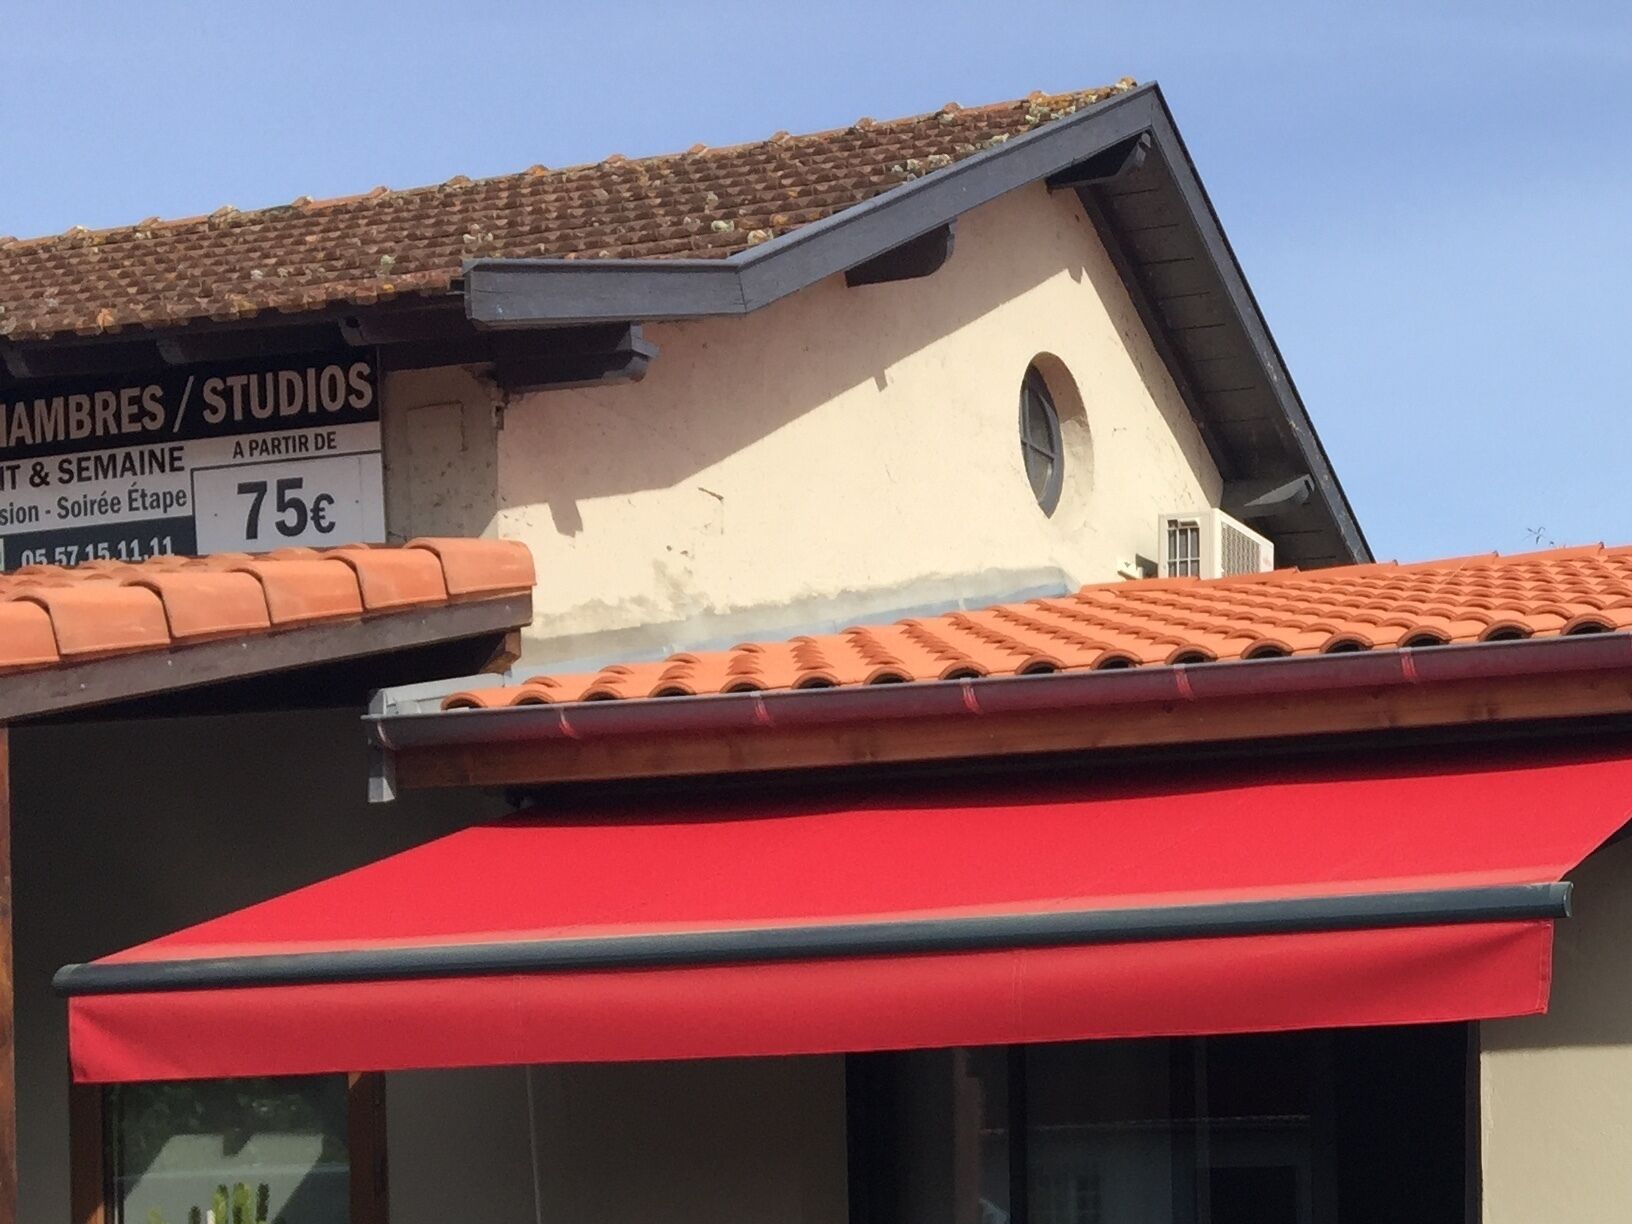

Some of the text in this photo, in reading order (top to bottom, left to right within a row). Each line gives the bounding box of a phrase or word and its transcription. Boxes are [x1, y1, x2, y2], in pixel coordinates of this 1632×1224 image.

[0, 385, 165, 448] AMBRES
[202, 361, 373, 424] STUDIOS
[233, 431, 337, 459] A PARTIR DE
[29, 461, 50, 488] &
[57, 446, 185, 484] SEMAINE
[57, 490, 121, 519] Soirée
[127, 481, 187, 514] Étape
[237, 477, 336, 540] 75€
